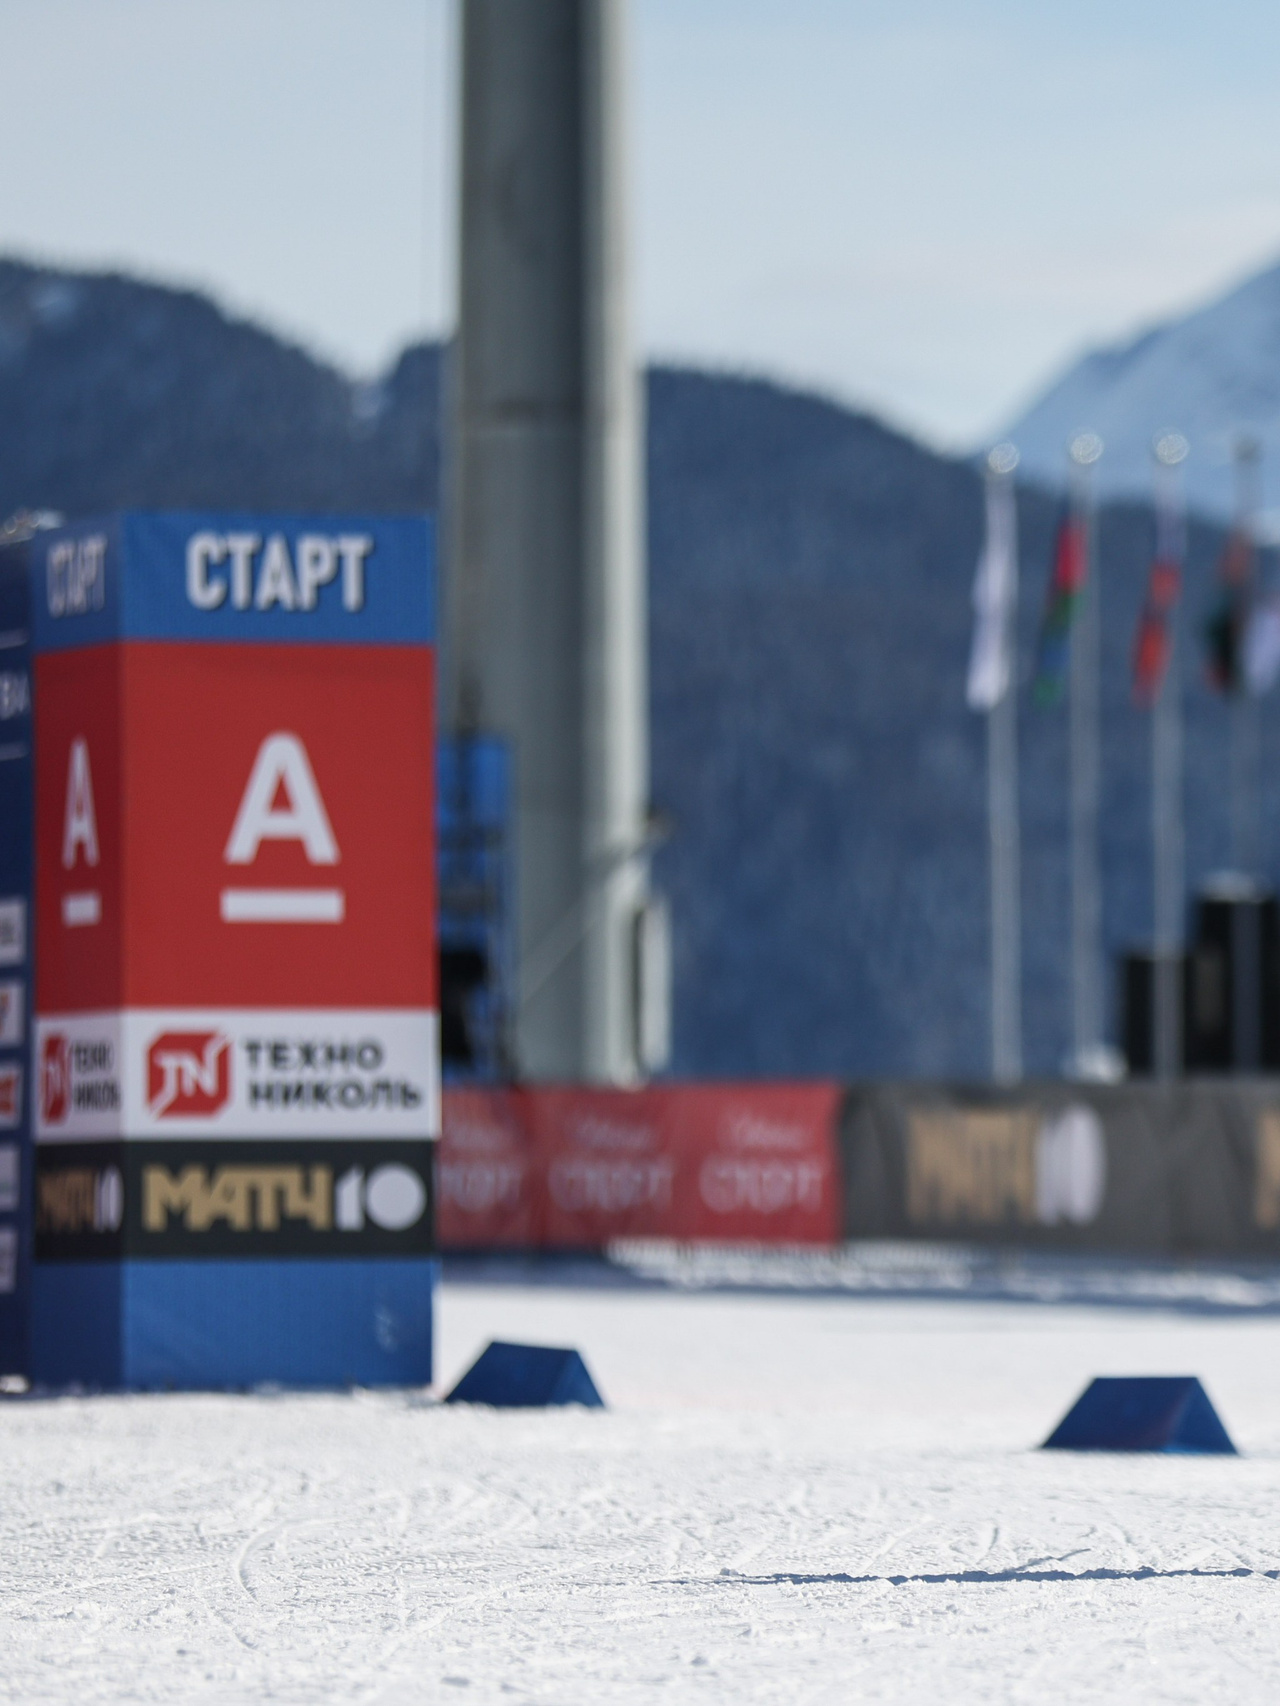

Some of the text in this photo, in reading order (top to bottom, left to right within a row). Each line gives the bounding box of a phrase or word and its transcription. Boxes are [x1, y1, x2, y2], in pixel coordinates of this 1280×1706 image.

[186, 531, 373, 612] СТАРТ
[244, 1038, 384, 1071] ТЕХНО
[249, 1081, 422, 1110] НИКОЛЬ
